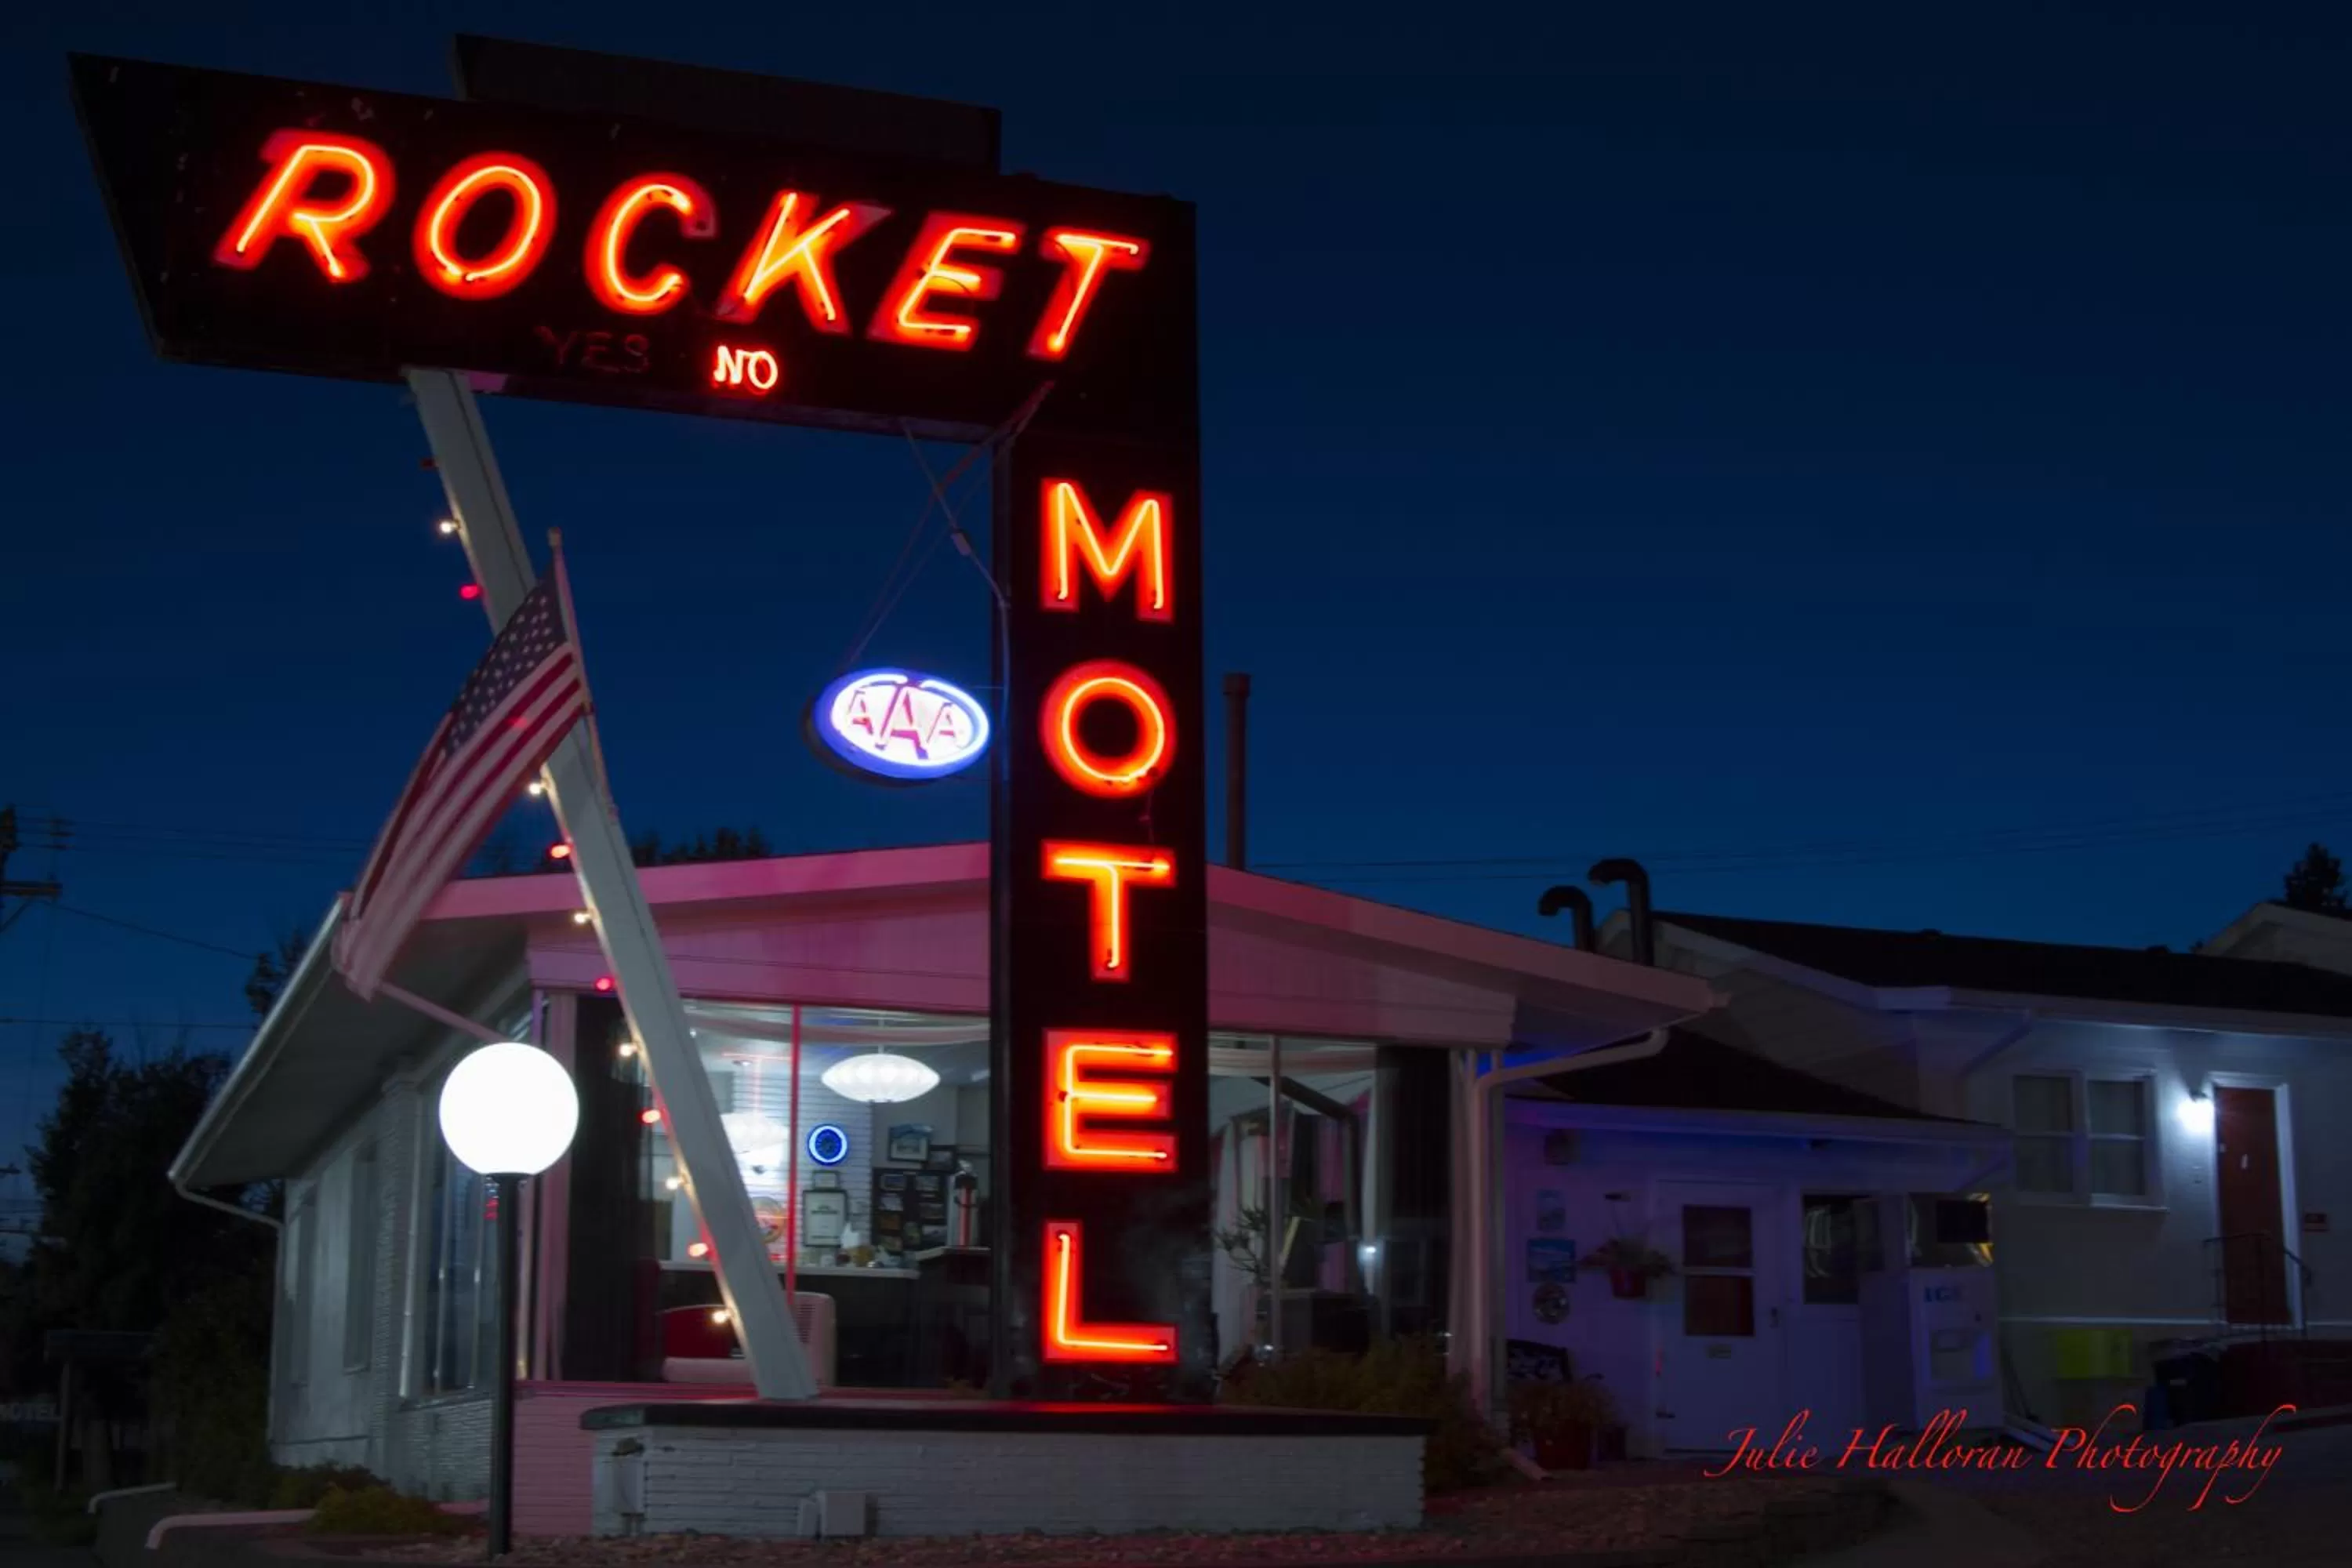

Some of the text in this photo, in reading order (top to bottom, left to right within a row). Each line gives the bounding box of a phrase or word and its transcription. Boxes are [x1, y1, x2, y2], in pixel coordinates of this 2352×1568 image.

[212, 128, 1151, 361] ROCKET
[532, 323, 779, 391] YES NO
[847, 682, 972, 760] AAA
[1038, 477, 1180, 1364] MOTEL
